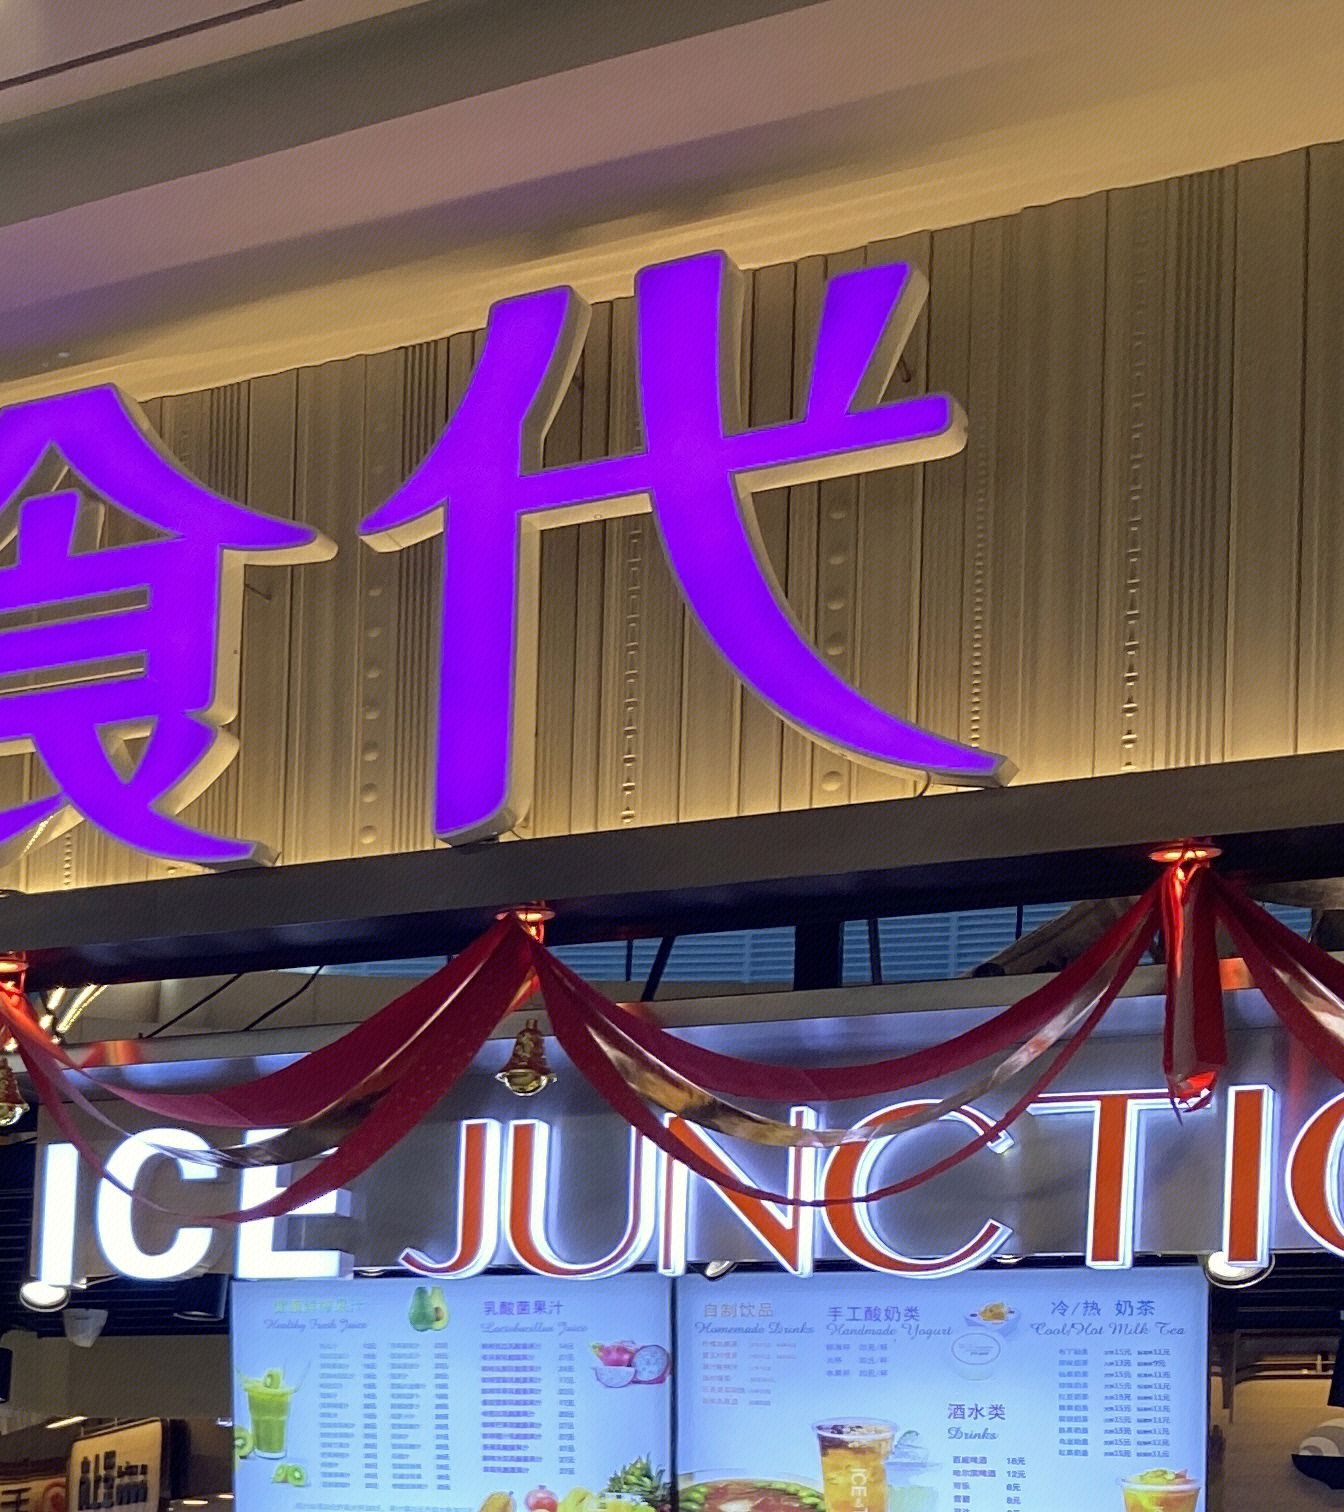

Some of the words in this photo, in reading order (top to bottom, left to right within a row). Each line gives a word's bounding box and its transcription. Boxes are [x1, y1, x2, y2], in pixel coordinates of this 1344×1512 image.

[39, 1125, 354, 1286] ICE
[483, 1300, 565, 1316] 乳酸菌果汁
[704, 1303, 774, 1318] 自制饮品
[827, 1305, 920, 1322] 手工酸奶类
[1050, 1299, 1101, 1317] 冷/热
[1114, 1299, 1156, 1317] 奶茶
[947, 1403, 1006, 1420] 酒水类
[947, 1426, 1000, 1440] Drinks
